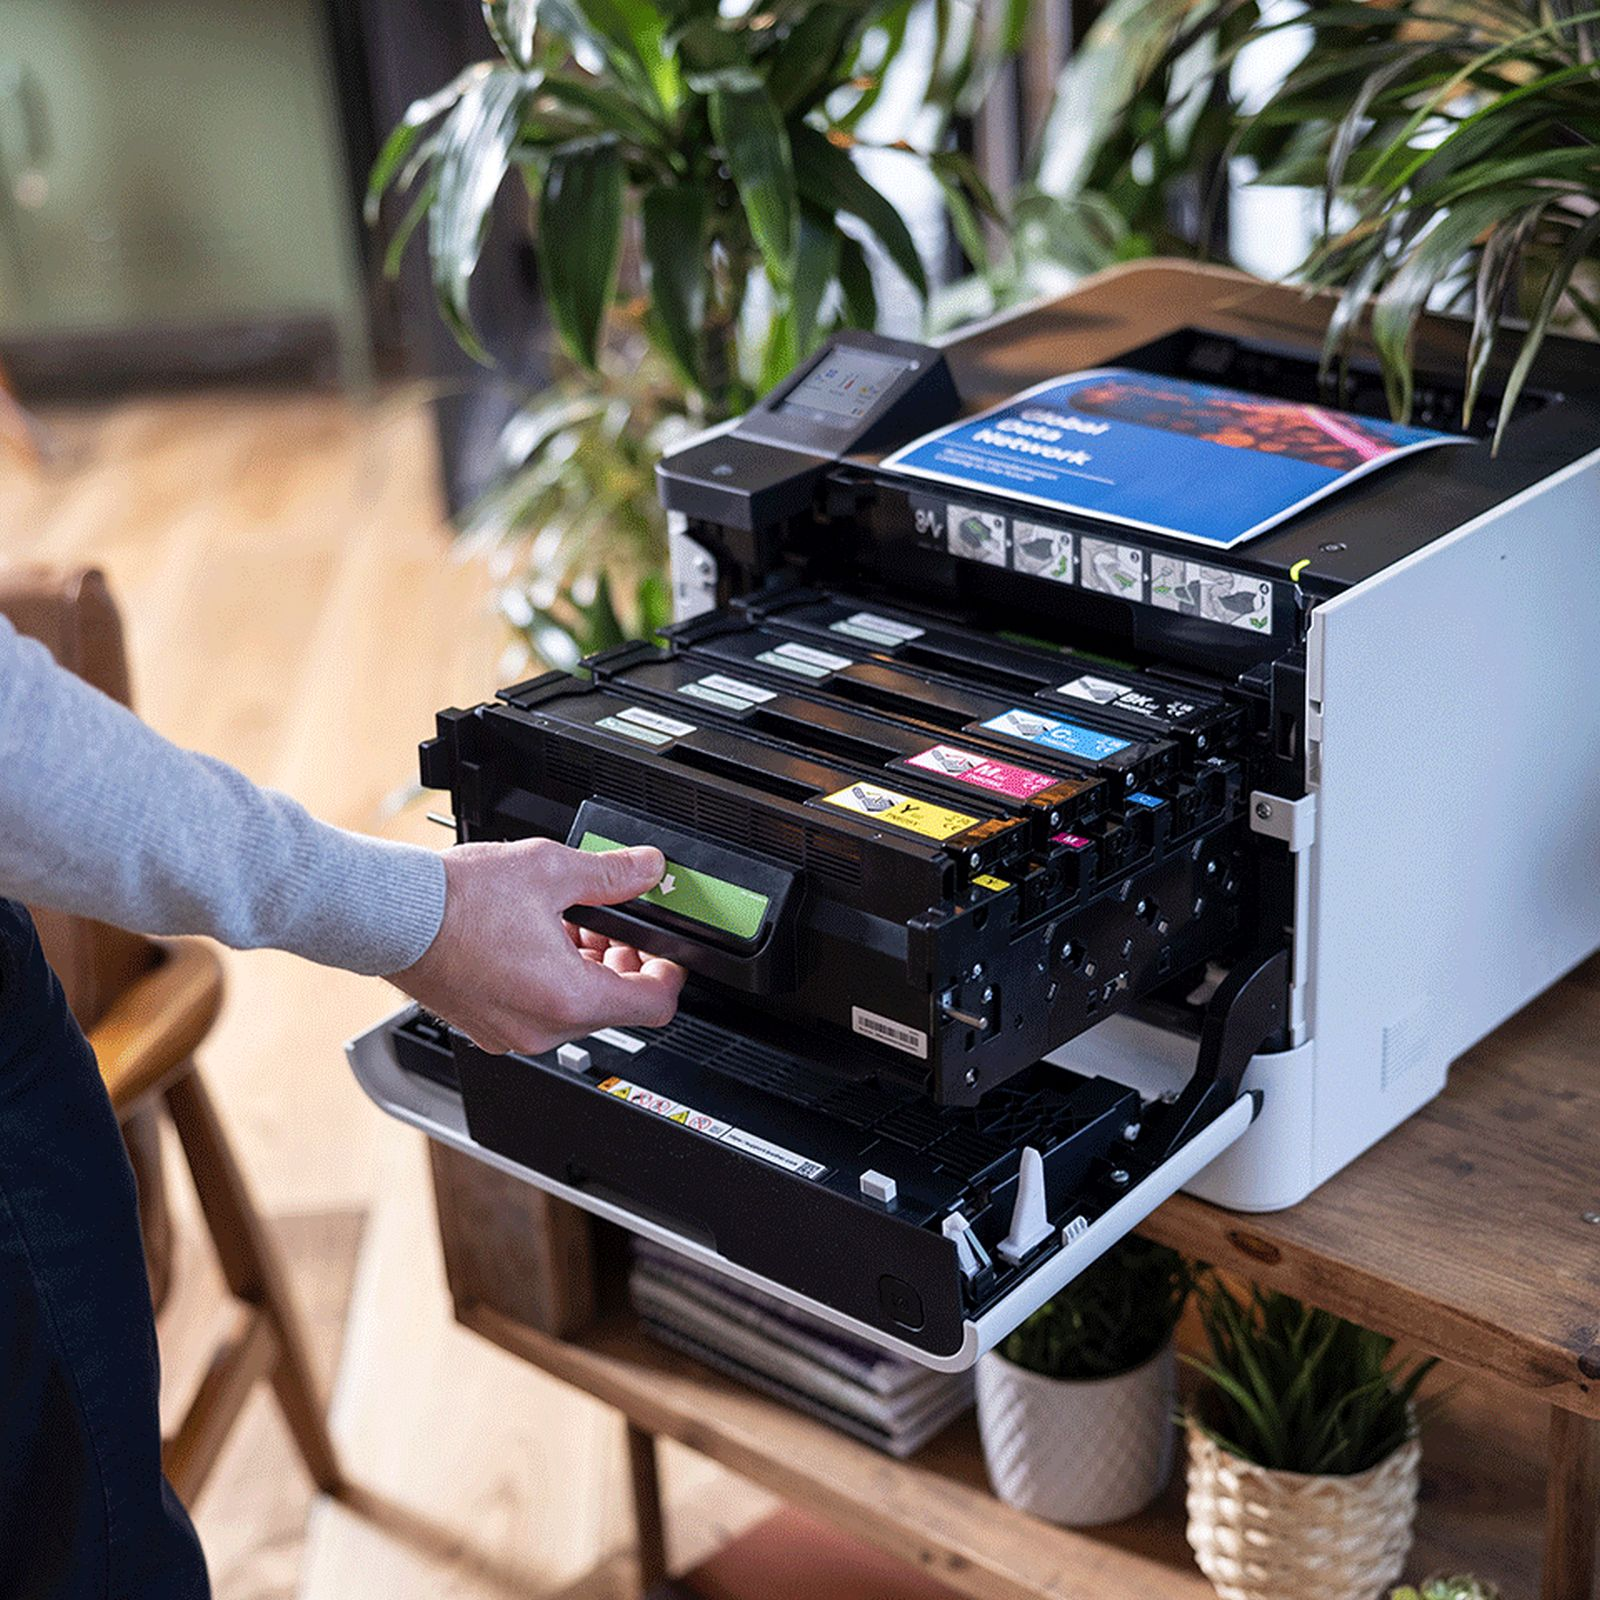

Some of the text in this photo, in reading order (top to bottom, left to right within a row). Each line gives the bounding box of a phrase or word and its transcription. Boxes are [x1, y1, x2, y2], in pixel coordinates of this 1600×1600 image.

[972, 428, 1093, 466] Network
[1119, 692, 1154, 706] BK
[1051, 729, 1072, 738] C
[974, 764, 1002, 777] M
[900, 804, 920, 814] Y
[1062, 835, 1079, 843] M
